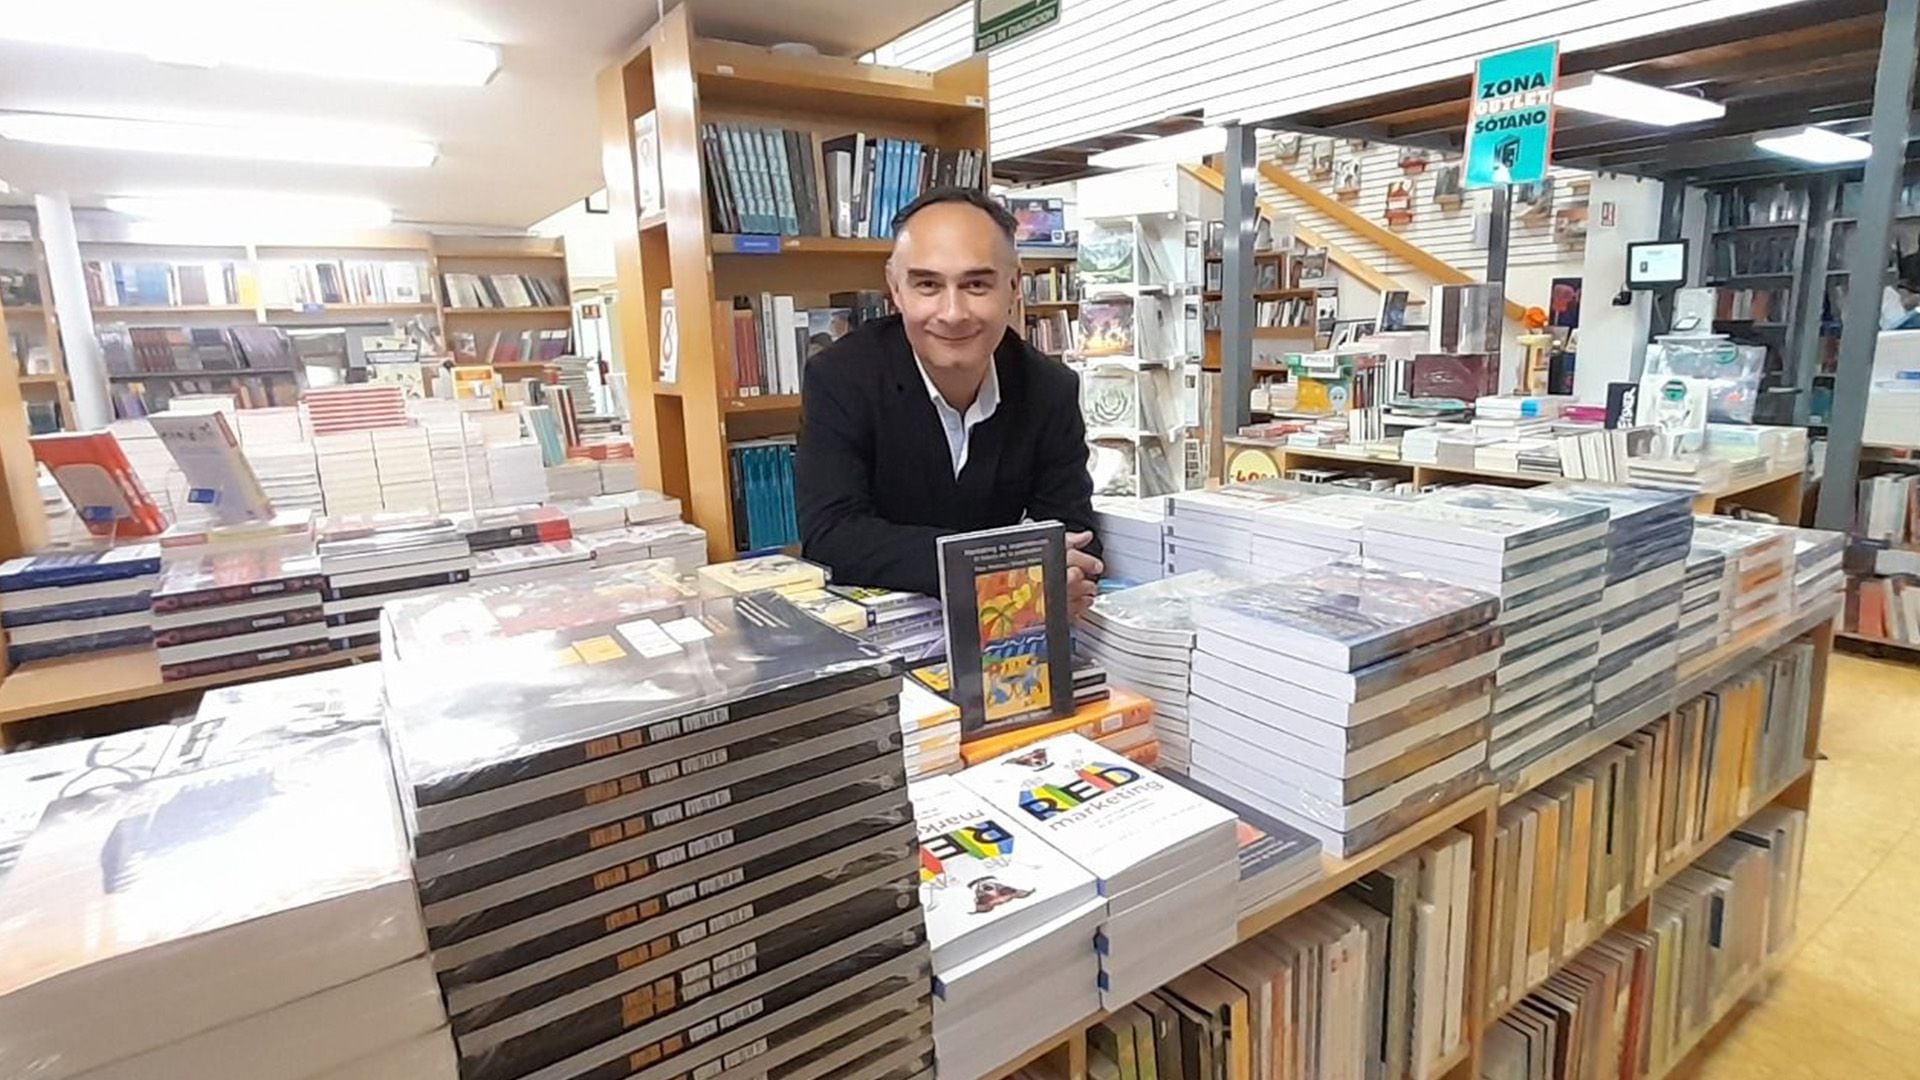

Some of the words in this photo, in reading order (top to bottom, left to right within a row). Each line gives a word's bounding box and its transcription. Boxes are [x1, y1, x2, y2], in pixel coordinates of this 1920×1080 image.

[1482, 72, 1546, 99] ZONA
[1475, 91, 1550, 116] OUTLET
[1018, 766, 1140, 822] RED
[1048, 780, 1164, 831] marketing
[917, 809, 985, 836] mark
